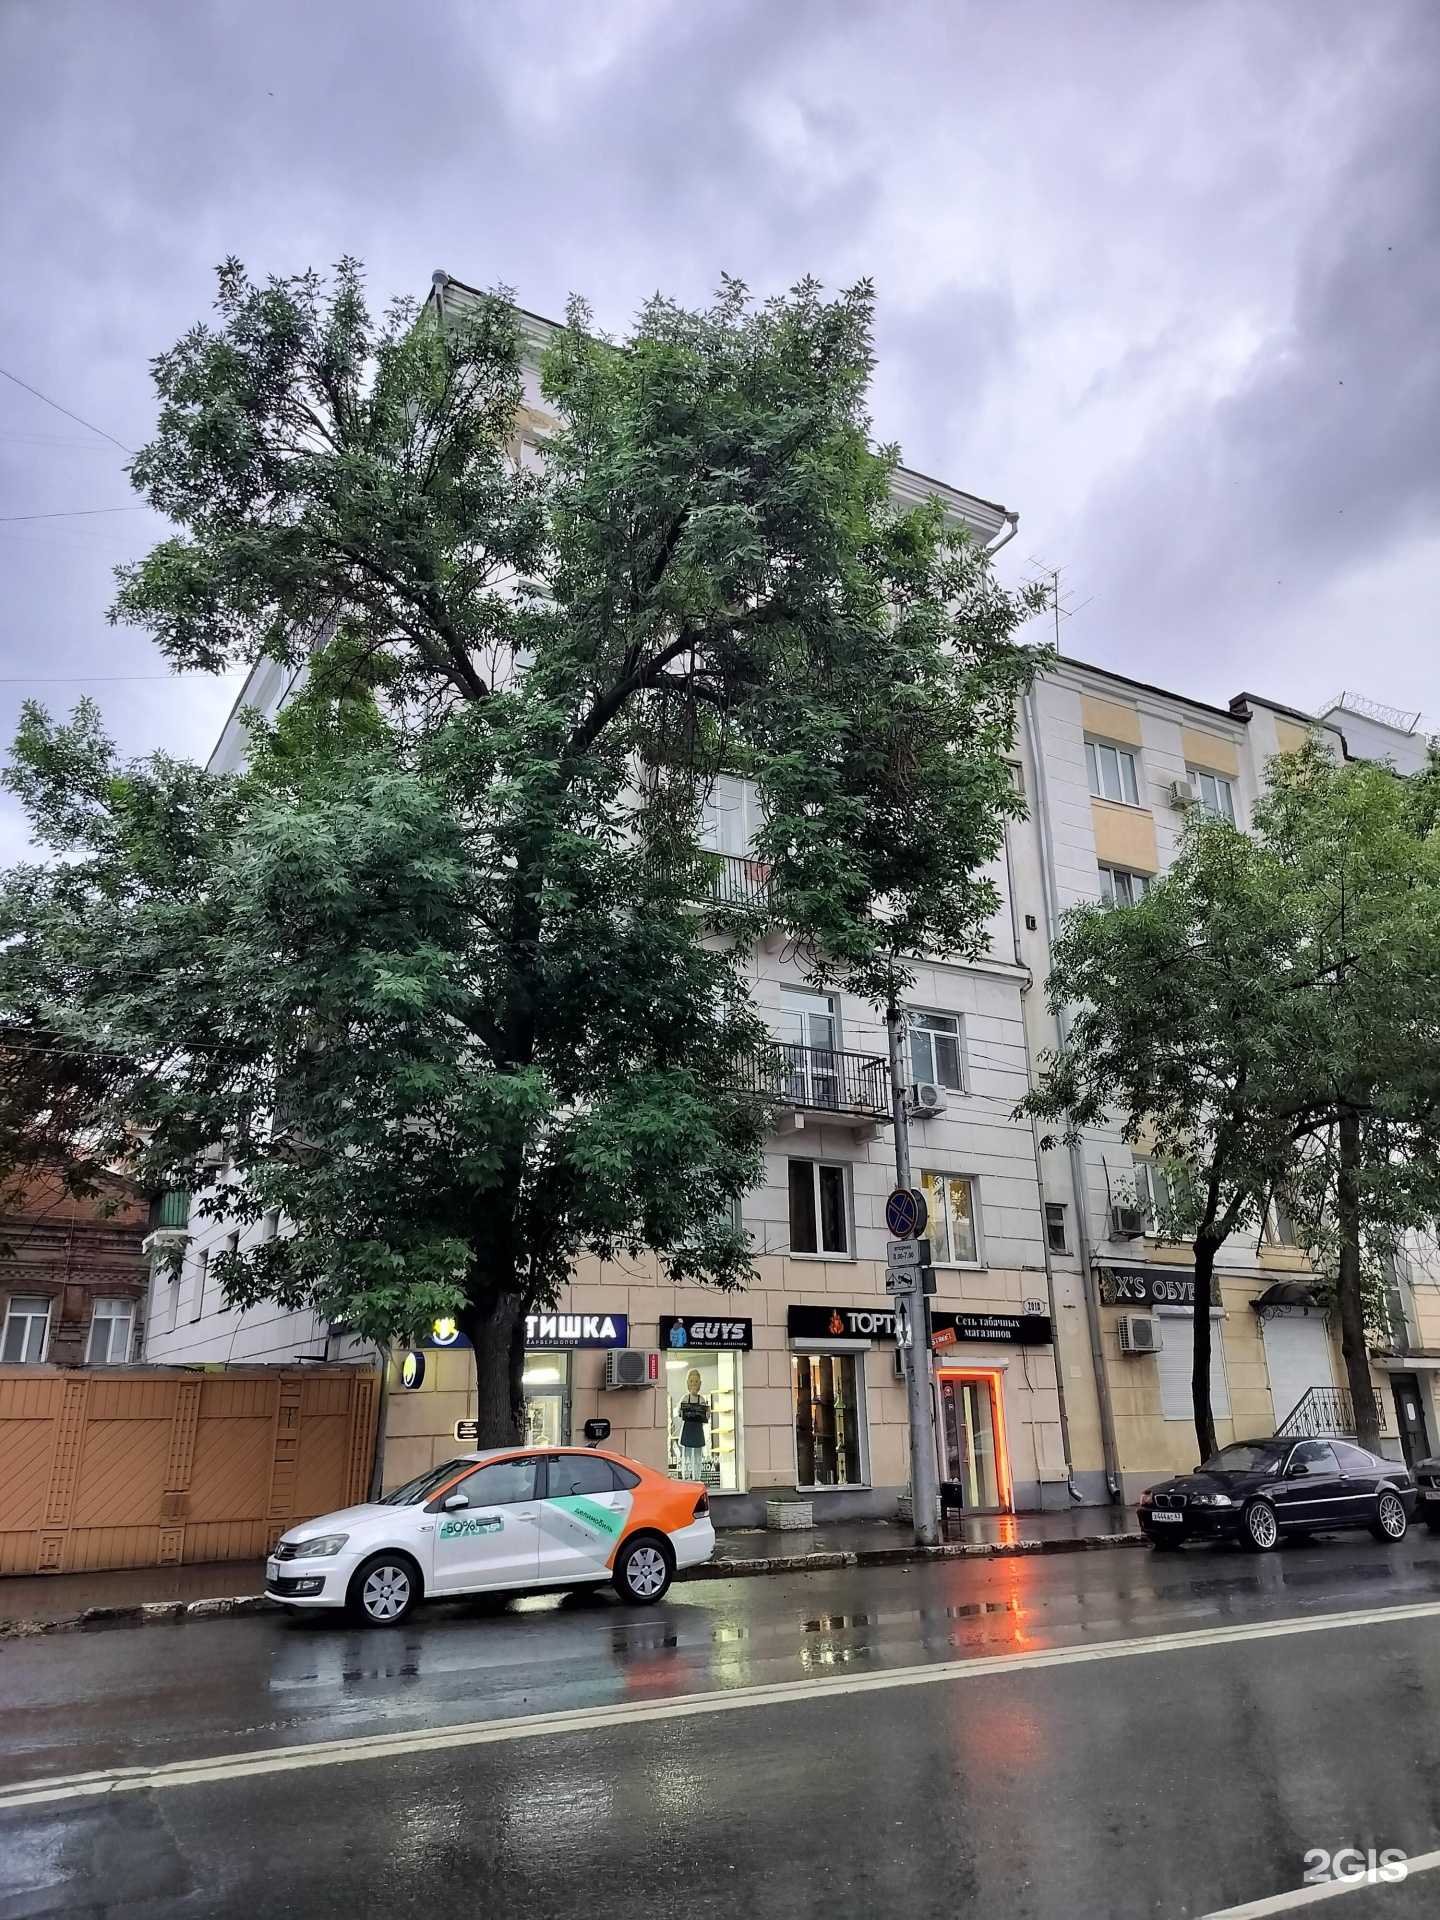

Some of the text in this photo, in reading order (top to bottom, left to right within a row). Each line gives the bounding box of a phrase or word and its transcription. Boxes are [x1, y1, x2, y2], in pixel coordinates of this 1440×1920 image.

[1152, 1280, 1195, 1300] ОБУВ
[524, 1315, 617, 1339] ТИШКА
[955, 1315, 1021, 1328] Сеть табачных
[690, 1322, 746, 1340] GUYS
[964, 1329, 1012, 1339] магазинов
[441, 1520, 476, 1534] -50%
